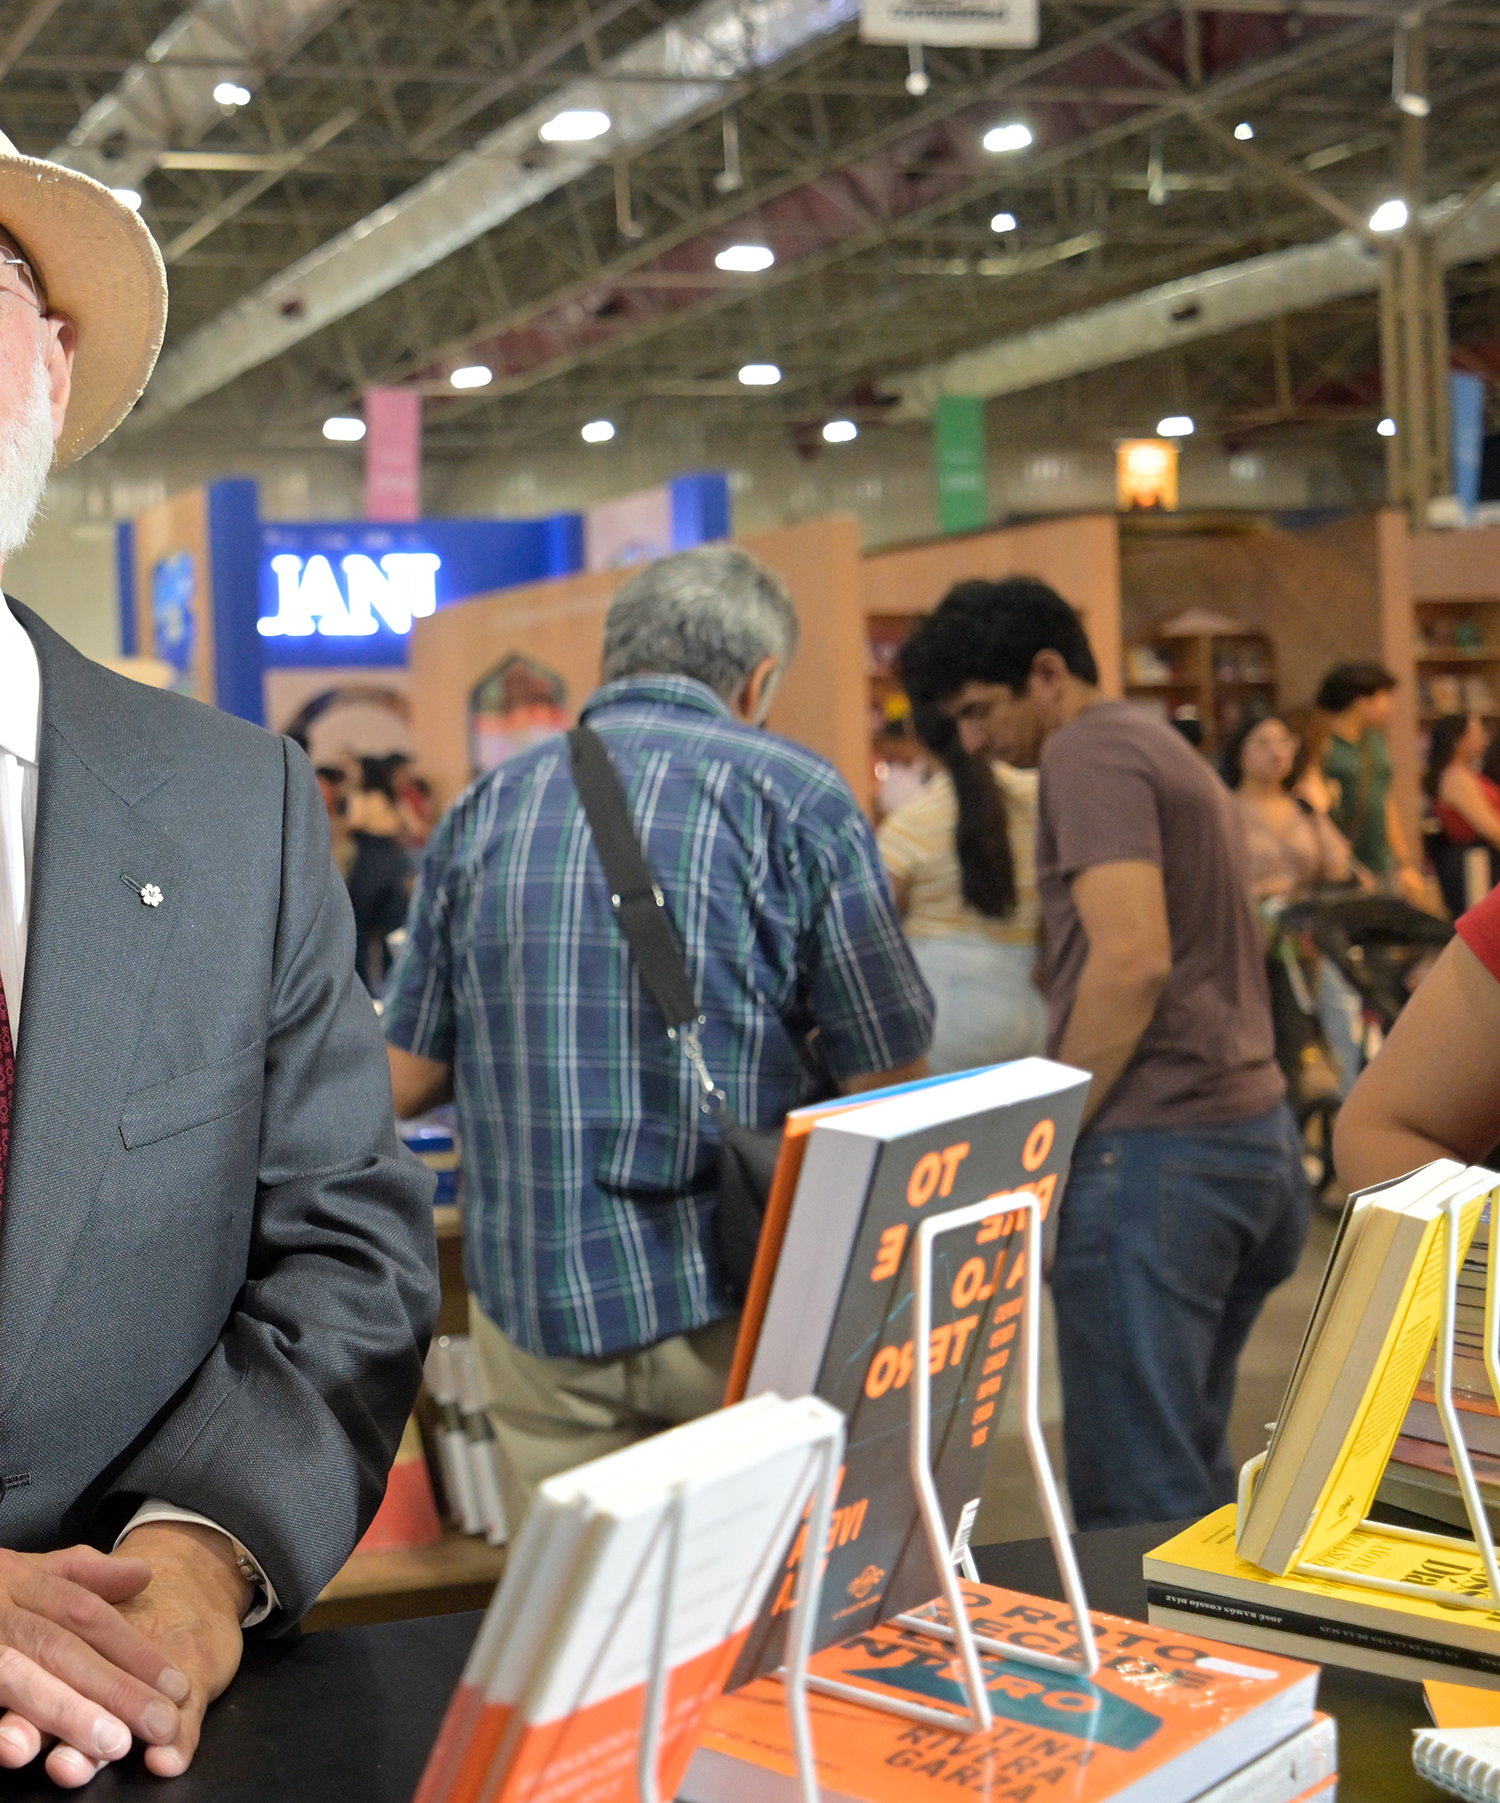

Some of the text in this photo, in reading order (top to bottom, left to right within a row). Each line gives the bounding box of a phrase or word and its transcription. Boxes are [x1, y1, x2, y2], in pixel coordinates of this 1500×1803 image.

[1400, 1558, 1475, 1587] Día
[1165, 1594, 1283, 1624] JOSÉ RAMÓN COSSÍO DÍAZ
[1000, 1604, 1211, 1664] ROTO
